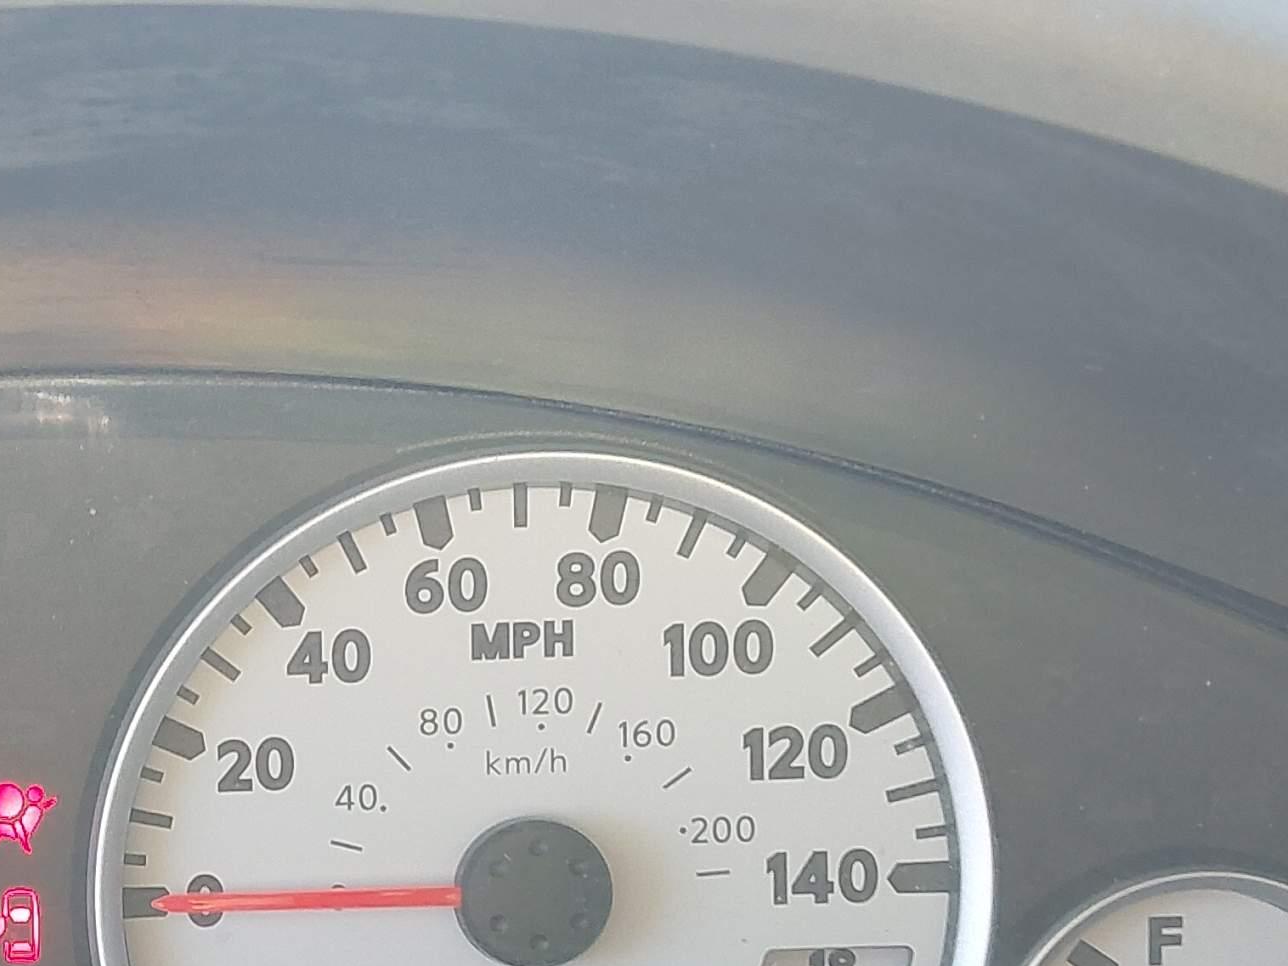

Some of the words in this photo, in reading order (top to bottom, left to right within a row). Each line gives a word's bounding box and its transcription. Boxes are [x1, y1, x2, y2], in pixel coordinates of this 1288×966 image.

[404, 557, 489, 613] 60
[556, 550, 640, 607] 80
[286, 628, 372, 684] 40
[470, 620, 575, 662] MPH
[663, 620, 774, 677] 100
[419, 709, 463, 736] 80
[517, 689, 574, 717] 120
[619, 719, 677, 748] 160
[742, 724, 848, 781] 120
[216, 737, 295, 793] 20
[484, 748, 569, 775] km/h
[766, 850, 878, 905] 140
[1149, 916, 1183, 966] F
